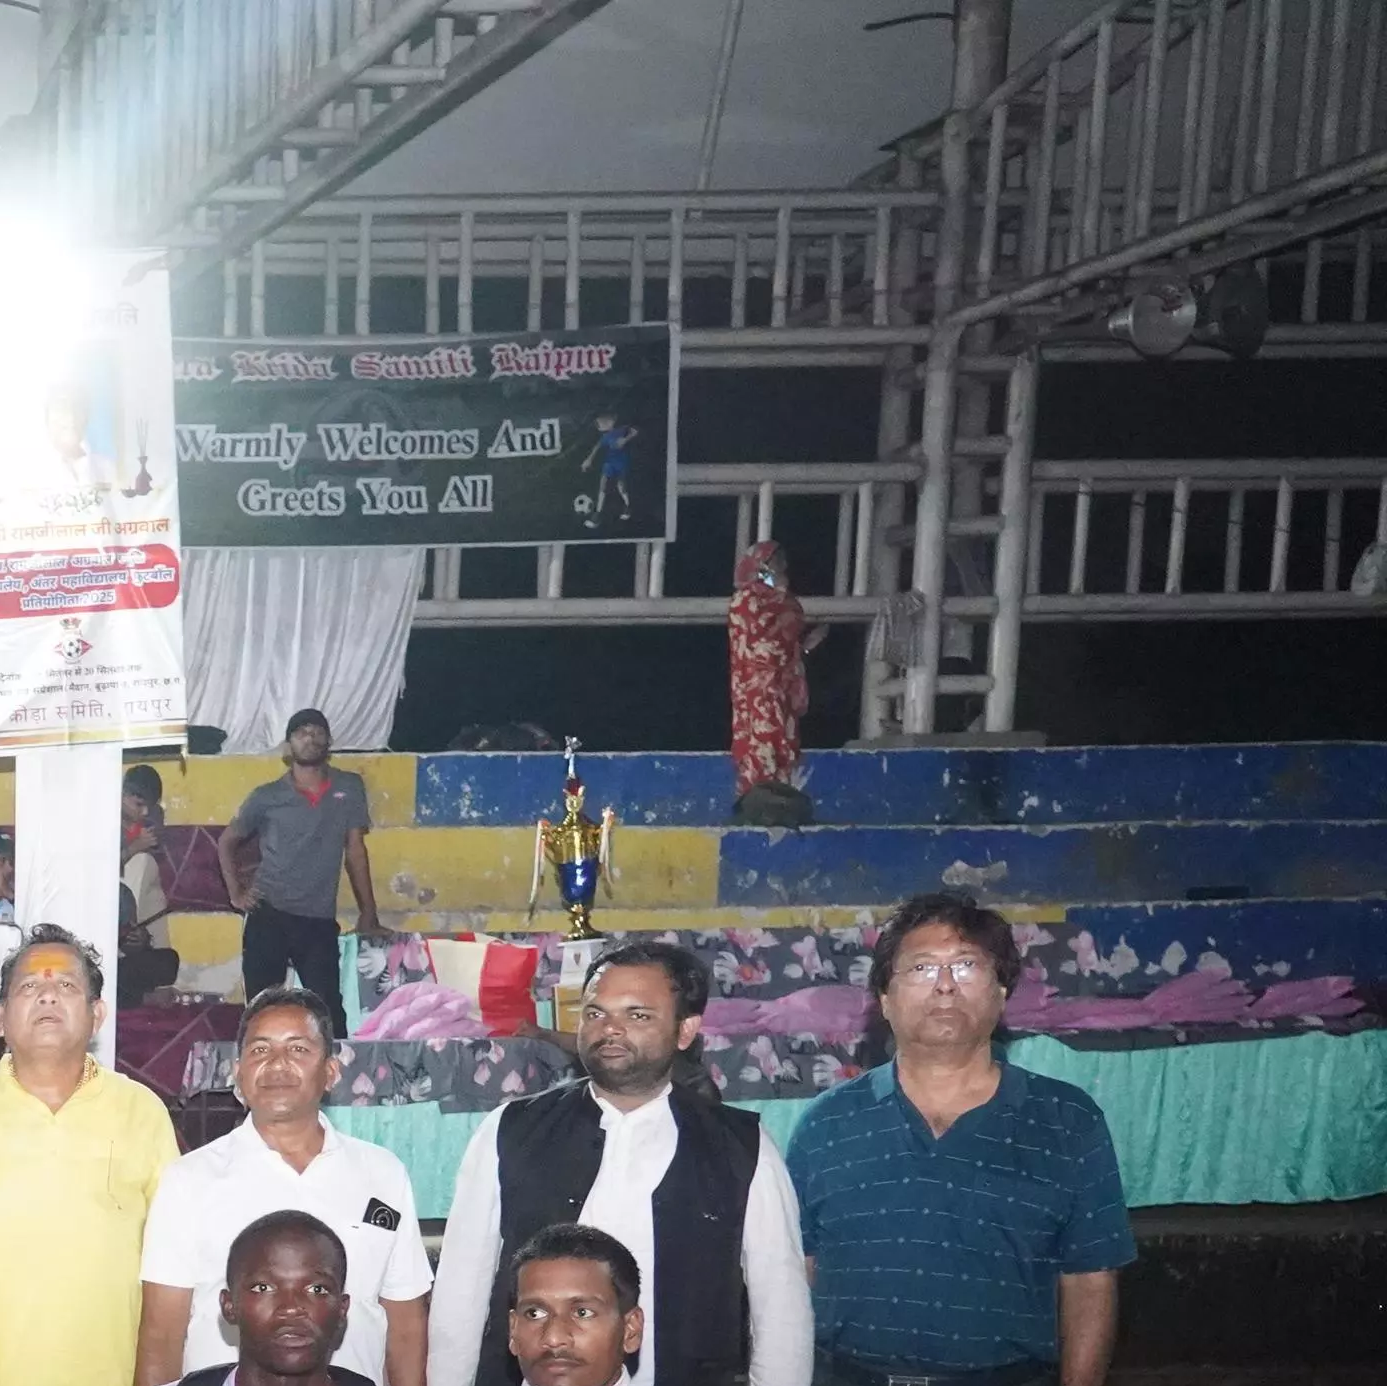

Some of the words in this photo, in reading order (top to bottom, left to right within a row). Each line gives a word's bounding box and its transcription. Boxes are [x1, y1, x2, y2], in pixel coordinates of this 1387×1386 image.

[233, 352, 335, 380] Krida
[351, 349, 477, 380] Samiti
[490, 345, 615, 379] Raipur
[176, 424, 306, 468] Warmly
[317, 422, 478, 459] Welcomes
[488, 419, 561, 457] And
[238, 480, 345, 514] Greets
[357, 478, 427, 513] You
[439, 475, 493, 512] All
[114, 517, 170, 538] अग्रवाल
